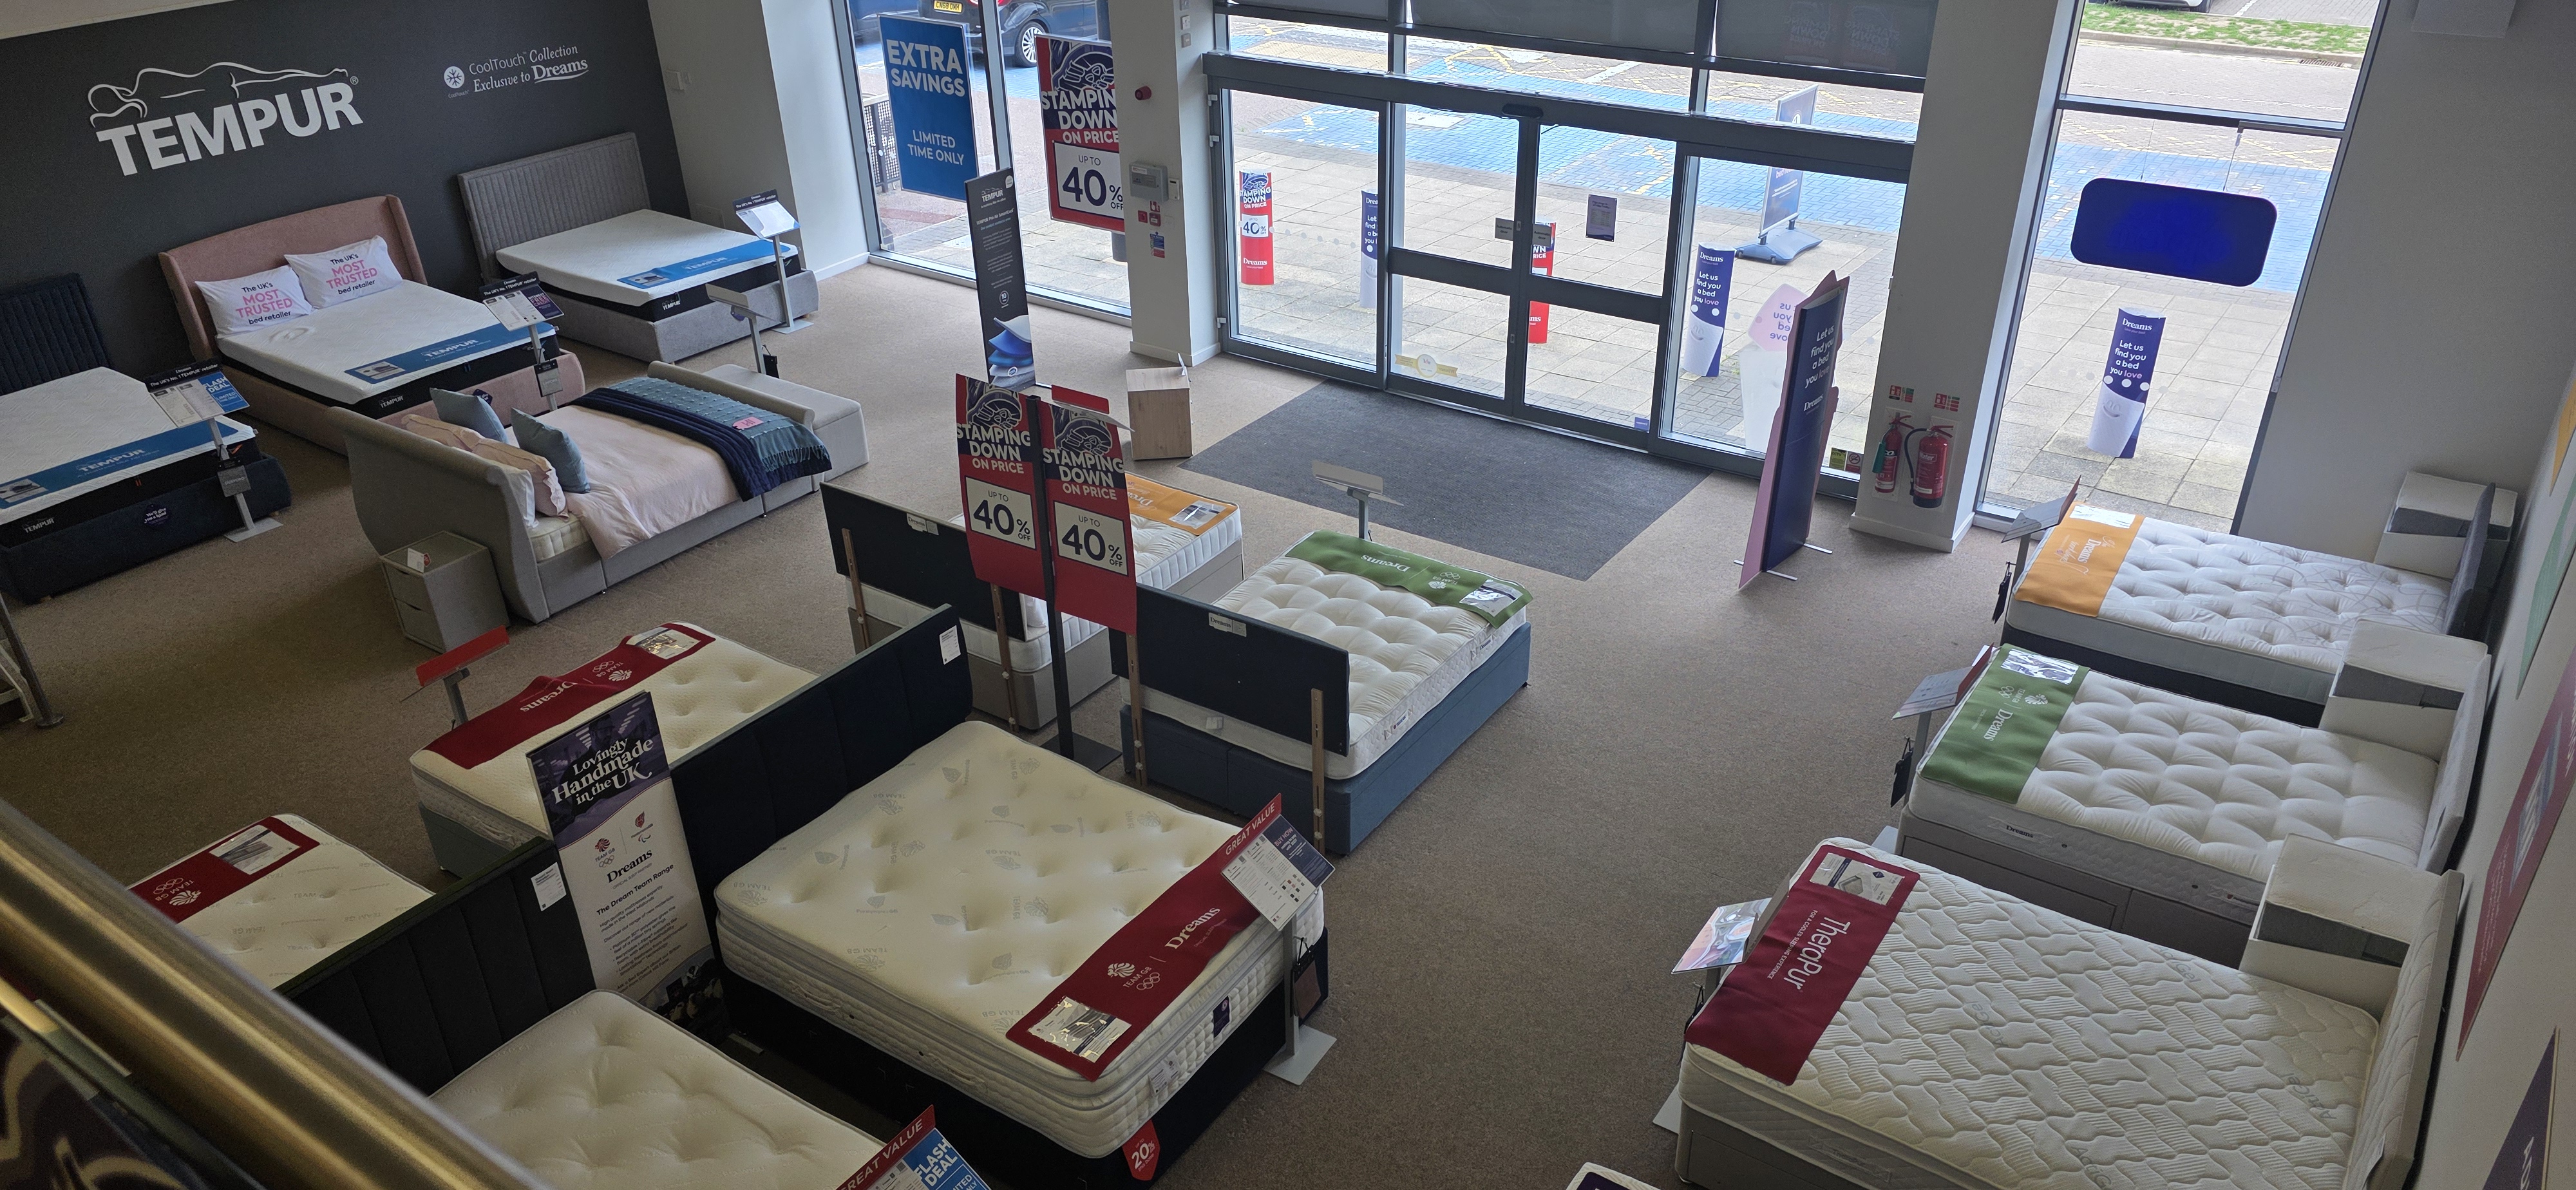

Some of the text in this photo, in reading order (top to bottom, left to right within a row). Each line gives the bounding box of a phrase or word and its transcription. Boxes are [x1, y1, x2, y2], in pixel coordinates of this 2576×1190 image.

[529, 45, 578, 63] Collection
[886, 39, 963, 74] EXTRA
[473, 59, 589, 92] Exclusive to Dreams
[891, 68, 965, 97] SAVINGS
[1041, 88, 1117, 109] STAMPIN
[1057, 109, 1117, 129] DOWN
[913, 129, 956, 149] LIMITED
[1063, 130, 1119, 144] ON PRICE
[907, 144, 965, 165] TIME ONLY
[1078, 155, 1101, 165] UP TO
[981, 190, 1003, 202] TEMPUR
[1243, 257, 1267, 265] Dreams
[1700, 252, 1724, 263] Dreams
[332, 260, 365, 277] MOST
[1700, 271, 1709, 279] Let
[257, 281, 273, 290] UK's
[326, 268, 377, 289] TRUSTED
[352, 279, 375, 290] retailer
[1696, 279, 1721, 293] find you
[243, 289, 278, 305] MOST
[1694, 295, 1703, 305] you
[236, 298, 292, 318] TRUSTED
[249, 311, 291, 325] bed retailer
[2122, 317, 2152, 332] Dreams
[1816, 325, 1835, 342] Let us
[424, 339, 478, 357] TEMPUR
[1811, 337, 1835, 358] find you
[2119, 339, 2132, 350] Let
[1812, 354, 1830, 370] a bed
[2114, 348, 2146, 362] find you
[2110, 366, 2143, 379] you love
[2122, 360, 2139, 370] bed
[203, 377, 228, 388] FLASH
[1805, 366, 1830, 388] you love
[208, 382, 231, 393] DEAL
[216, 391, 237, 401] LIMITED
[379, 395, 404, 409] TEMPUR
[1804, 394, 1823, 411] Dreams
[957, 423, 1030, 446] STAMPING
[970, 441, 1021, 461] DOWN
[78, 449, 146, 472] TEMPUR
[972, 458, 1025, 474] ON PRICE
[1043, 448, 1124, 473] STAMPING
[1059, 466, 1114, 487] DOWN
[989, 489, 1009, 502] UP TO
[1062, 484, 1081, 495] ON
[1083, 486, 1117, 501] PRICE
[24, 518, 55, 533] TEMPUR
[1078, 515, 1101, 527] UP TO
[1018, 533, 1030, 542] OFF
[2077, 538, 2101, 563] Dreams
[1109, 558, 1123, 567] OFF
[1360, 554, 1411, 573] Dreams
[1210, 617, 1231, 628] Dreams
[607, 660, 625, 675] TEAM
[520, 681, 578, 713] Dreams
[1984, 708, 2013, 741] Dreams
[573, 739, 628, 775] Lovingly
[551, 739, 654, 804] Handmade
[576, 762, 652, 805] in the UK
[1226, 802, 1275, 856] GREAT VALUE
[1274, 827, 1294, 847] BUY NOW
[2006, 824, 2034, 838] Dreams
[595, 847, 616, 862] TEAM GB
[606, 849, 653, 883] Dreams
[155, 880, 194, 902] TEAM GB
[596, 905, 610, 916] The
[611, 890, 634, 907] Dream
[634, 878, 652, 892] Team
[653, 864, 674, 880] Range
[1810, 909, 1818, 918] FOR
[1165, 907, 1220, 949] Dreams
[1797, 921, 1810, 937] COOLER
[1767, 956, 1787, 979] EXPERIENCE
[1123, 966, 1153, 988] TEAM GB
[882, 1119, 923, 1160] VALUE
[914, 1139, 951, 1180] FLASH
[925, 1154, 958, 1187] DEAL
